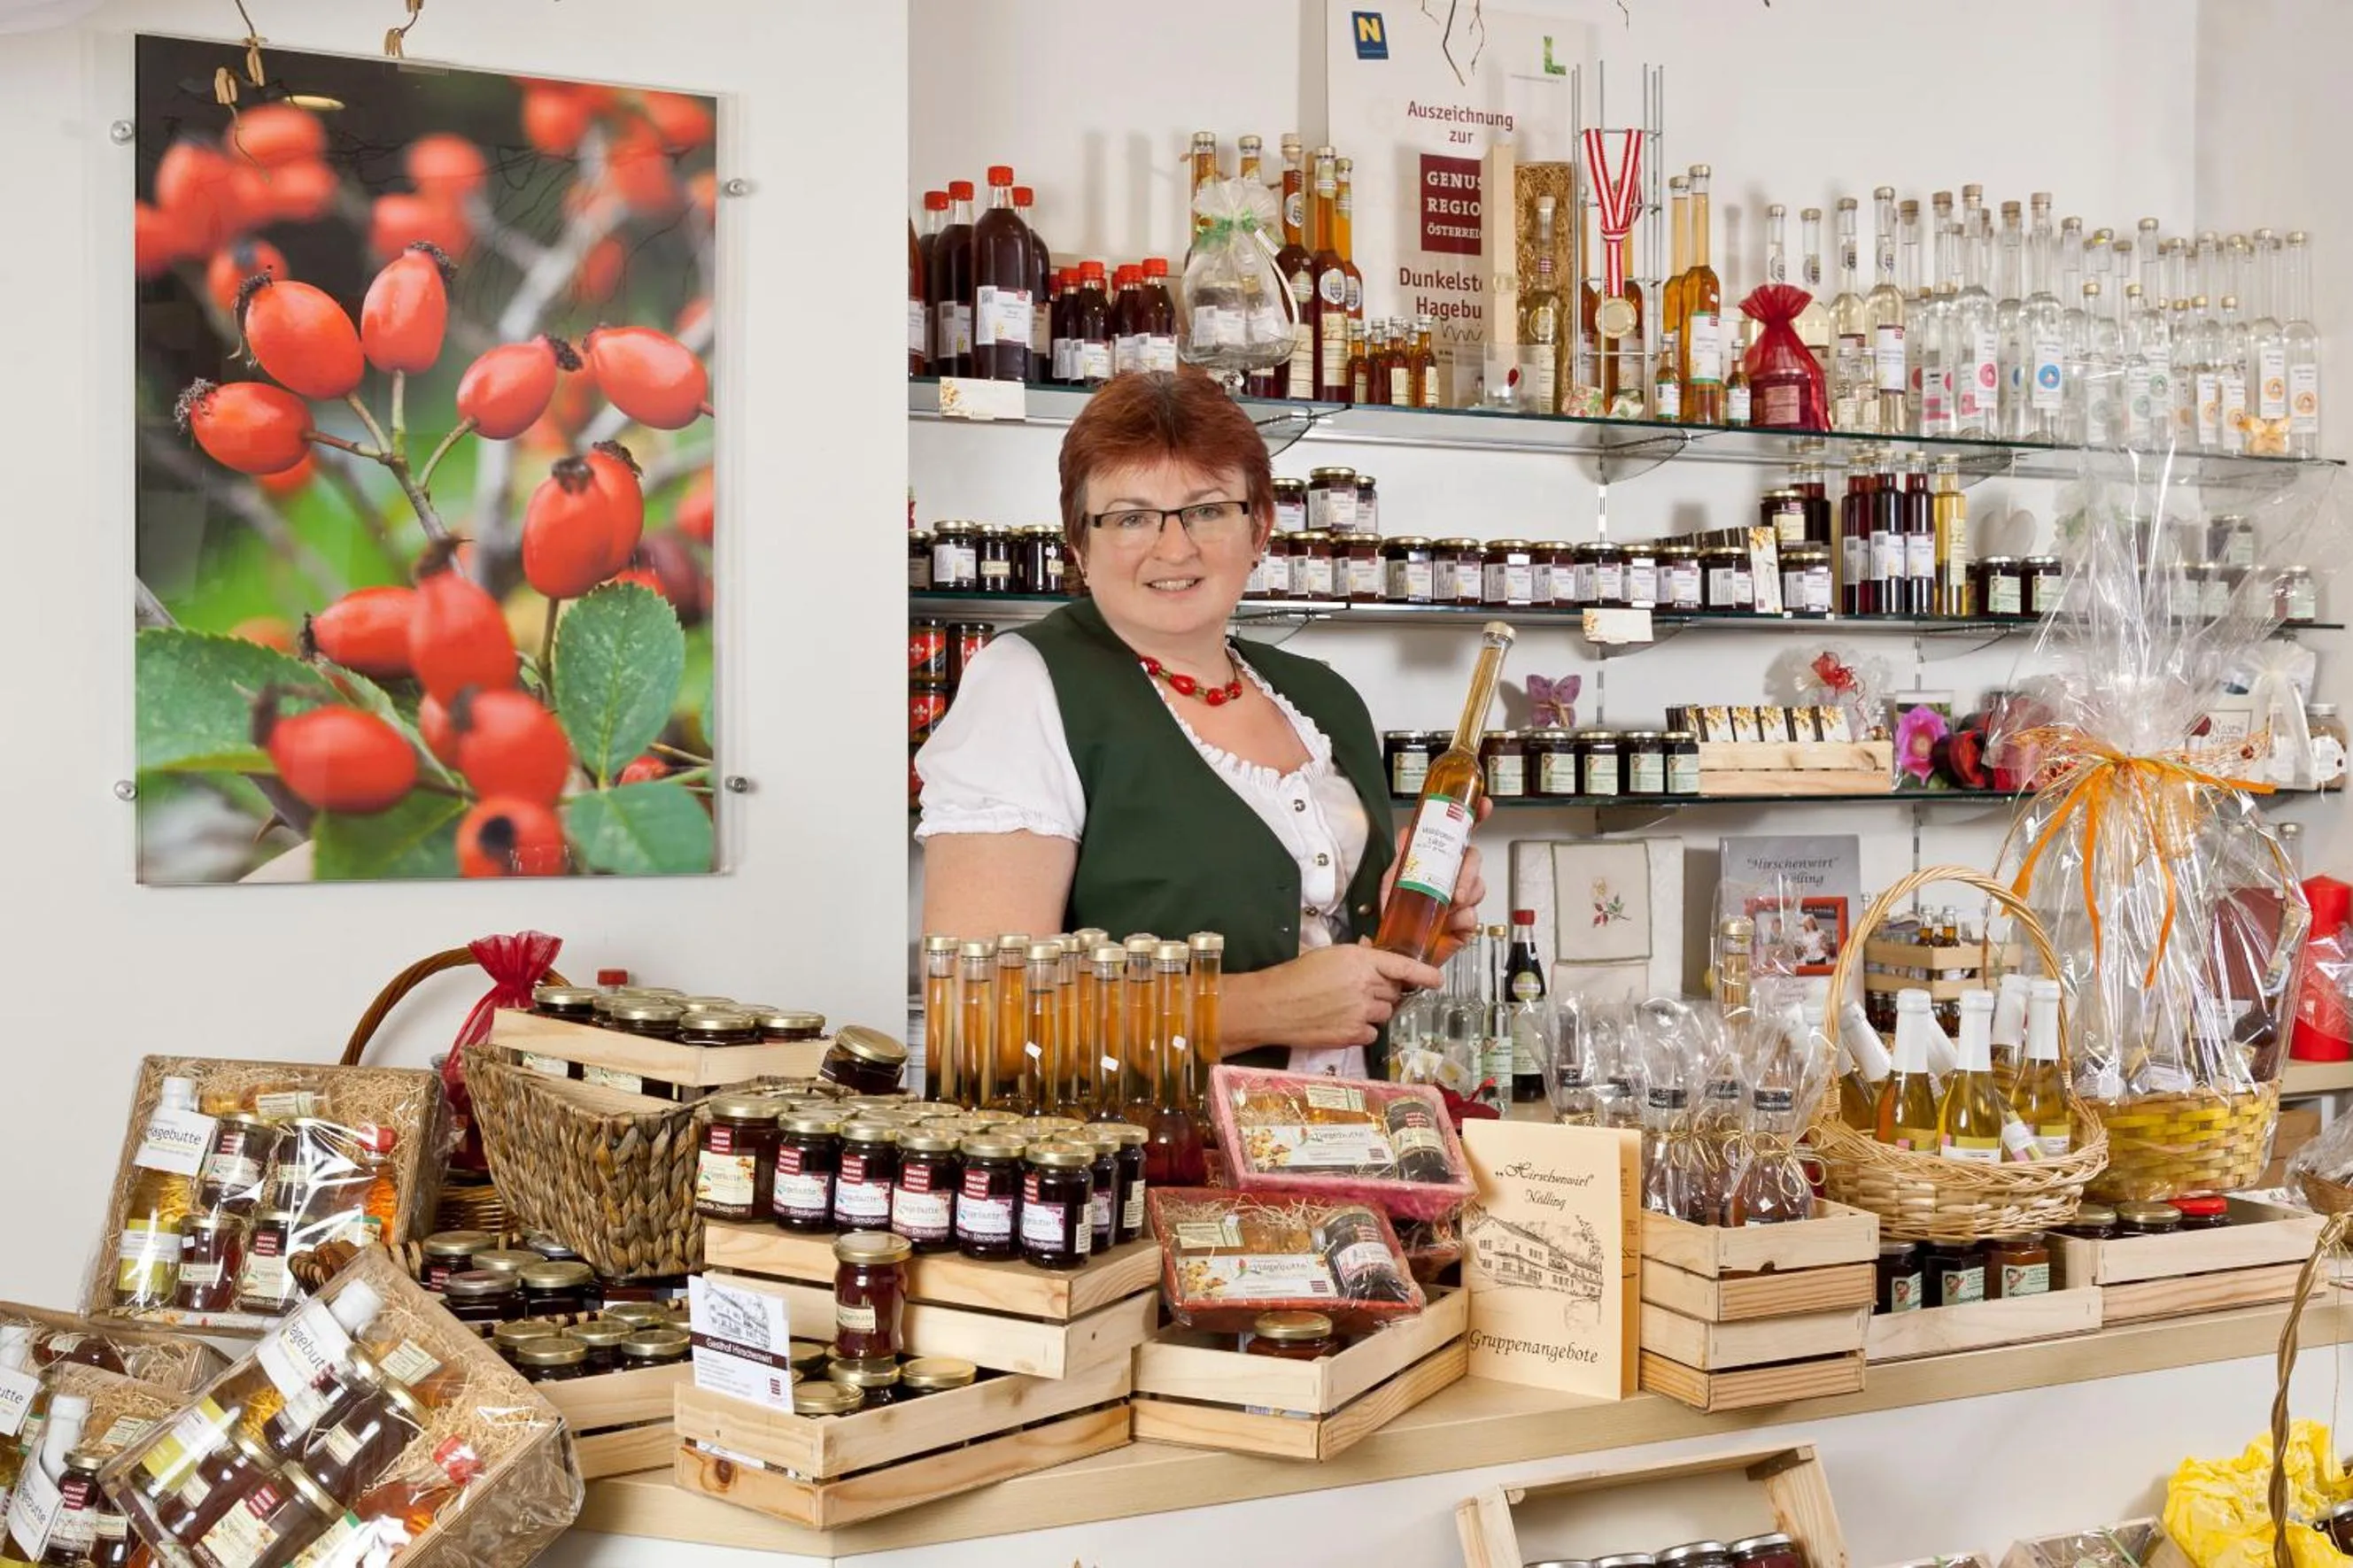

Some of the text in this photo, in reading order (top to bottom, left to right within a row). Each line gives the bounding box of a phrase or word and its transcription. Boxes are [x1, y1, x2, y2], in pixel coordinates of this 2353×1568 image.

[1357, 17, 1382, 42] N
[1408, 100, 1513, 131] Auszeichnung
[1449, 129, 1474, 143] zur
[1427, 197, 1482, 216] REGIO
[1417, 296, 1482, 321] Hagebu
[289, 1322, 327, 1371] agebut
[1469, 1328, 1598, 1363] Gruppenangebote
